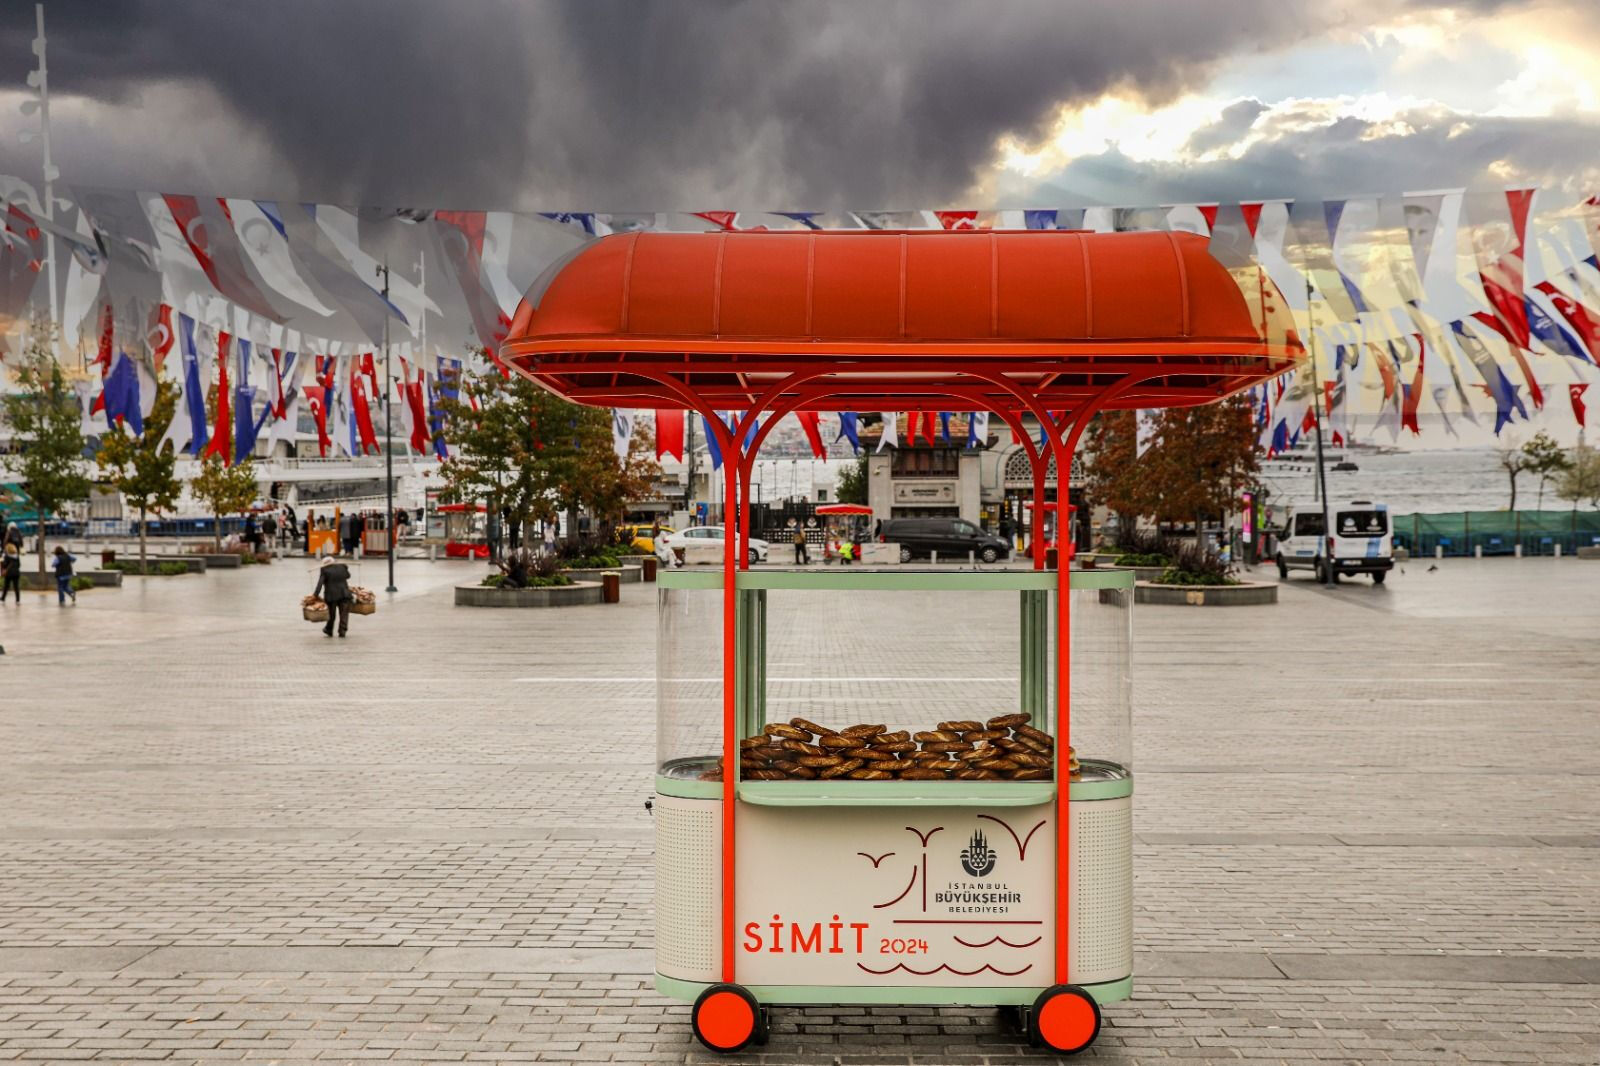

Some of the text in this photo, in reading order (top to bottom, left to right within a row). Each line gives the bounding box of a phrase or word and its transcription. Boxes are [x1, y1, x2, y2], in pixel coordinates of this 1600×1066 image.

[935, 891, 1021, 904] BÜYÜKŞEHİR
[743, 914, 929, 954] SİMİT 2024
